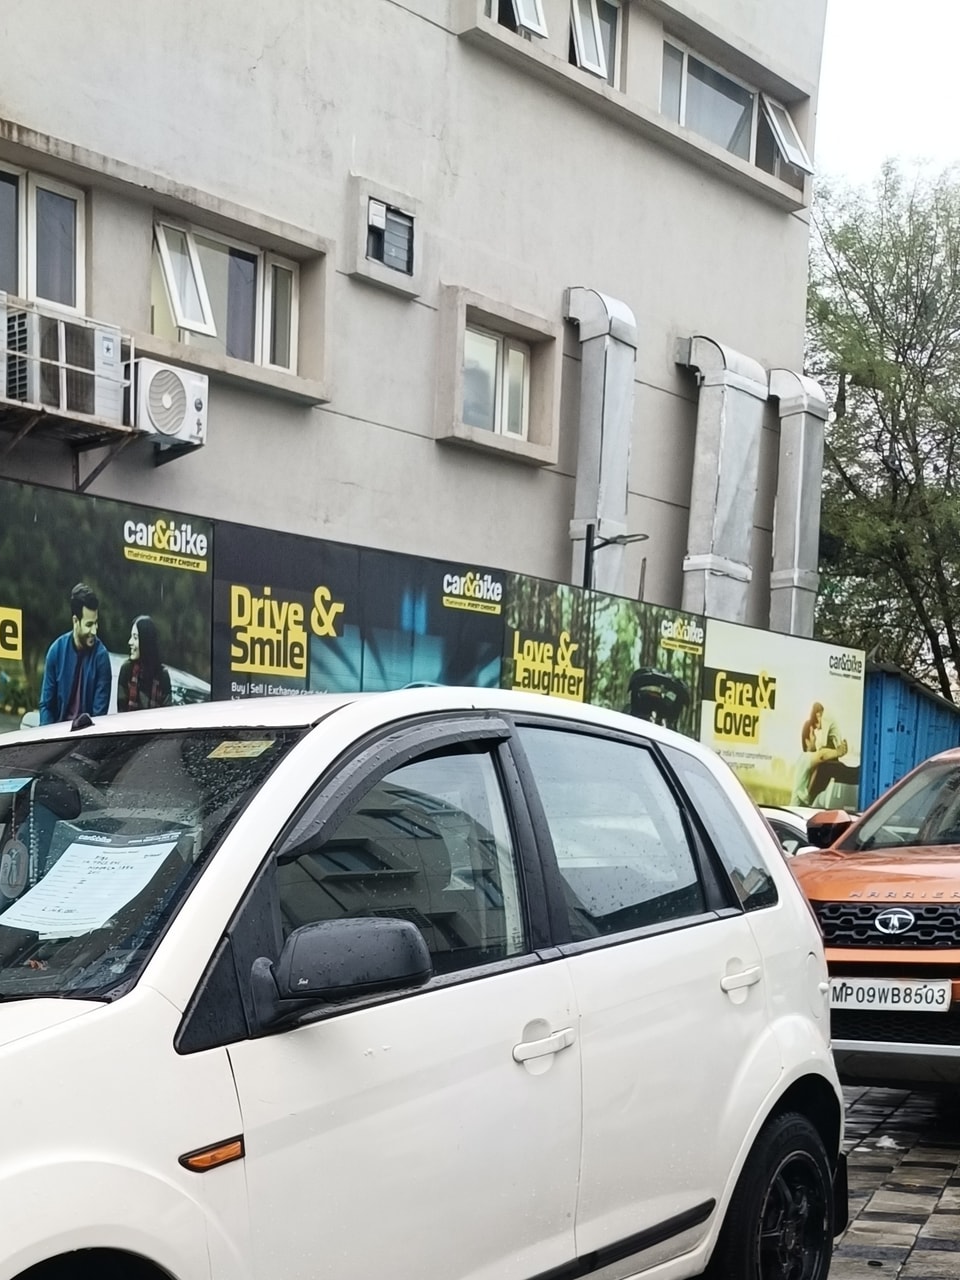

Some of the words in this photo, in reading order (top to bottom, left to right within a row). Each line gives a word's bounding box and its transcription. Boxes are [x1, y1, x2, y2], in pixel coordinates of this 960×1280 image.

[123, 520, 208, 556] car&bike
[159, 556, 178, 566] FIRST
[178, 560, 201, 568] CHOICE
[443, 572, 503, 601] car&bike
[231, 585, 304, 632] Drive
[311, 586, 344, 637] &
[231, 625, 305, 670] Smile
[514, 630, 554, 664] Love
[557, 631, 579, 668] &
[231, 682, 246, 695] Buy
[250, 684, 263, 694] Sell
[512, 660, 583, 696] Laughter
[715, 671, 753, 706] Care
[755, 670, 777, 710] &
[714, 703, 759, 737] Cover
[832, 984, 946, 1005] MP09WB8503
